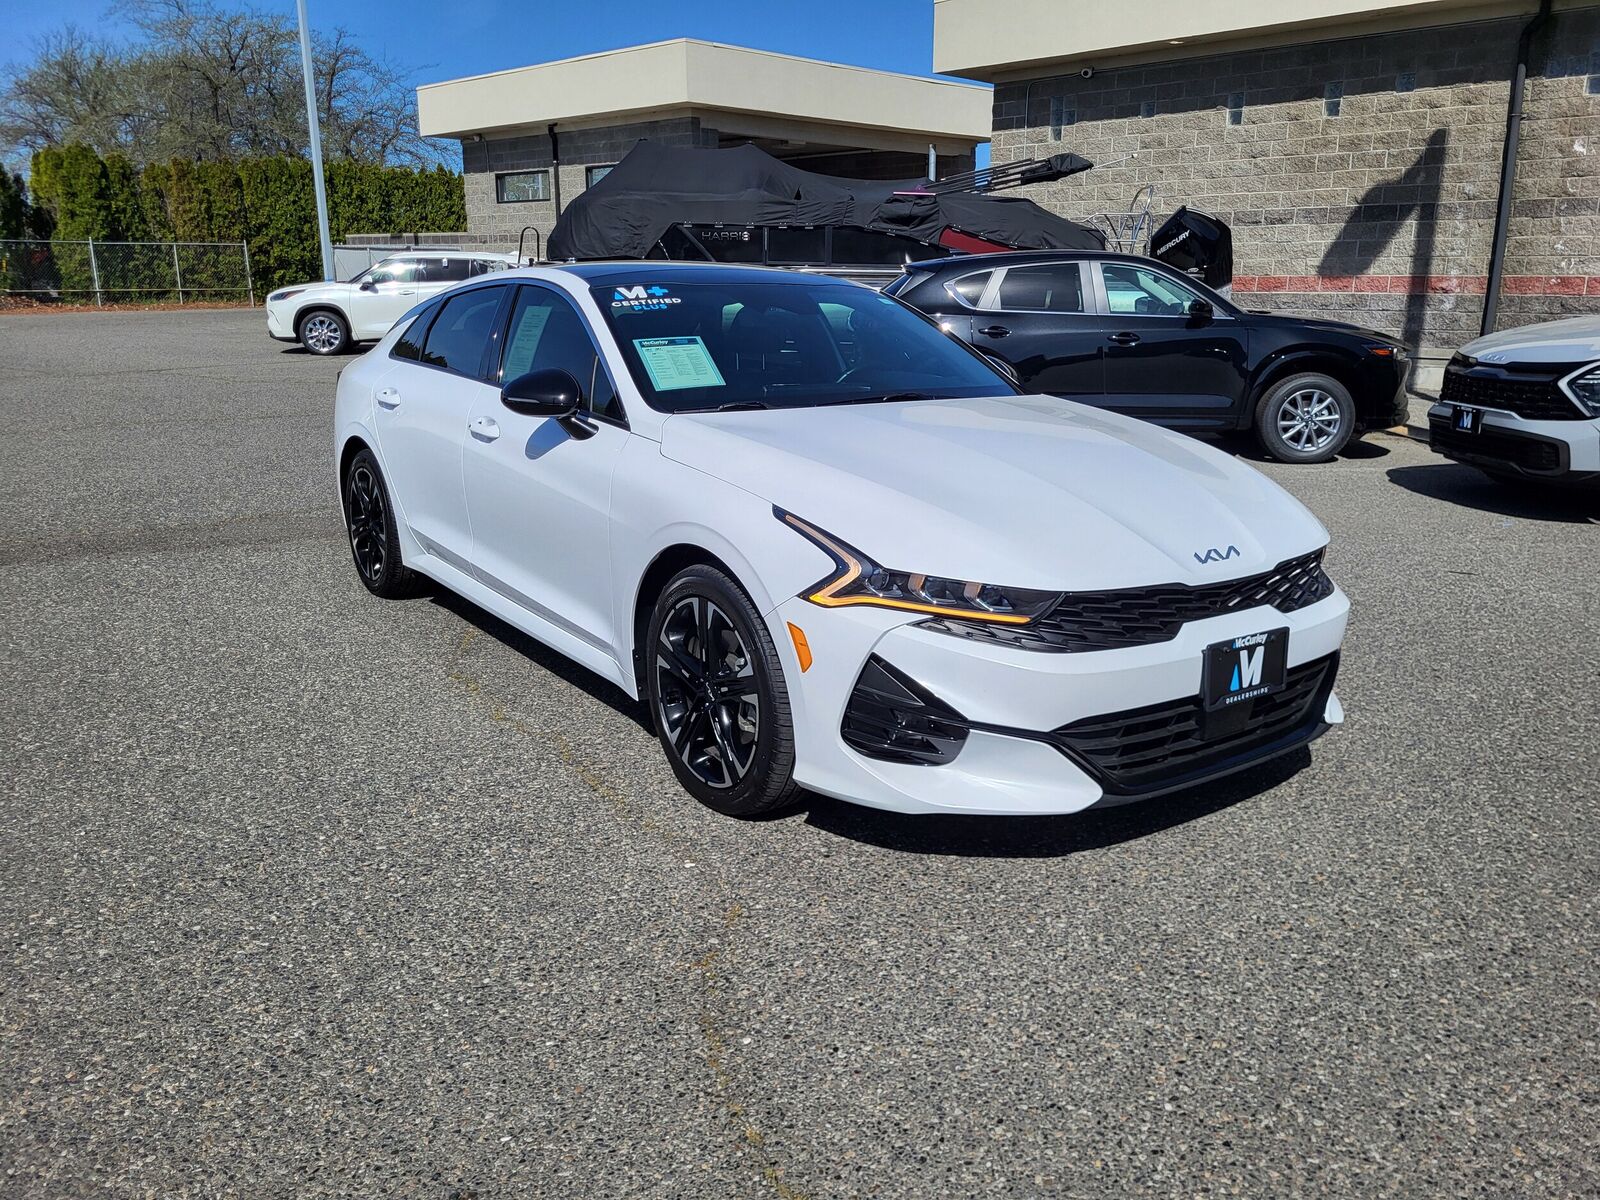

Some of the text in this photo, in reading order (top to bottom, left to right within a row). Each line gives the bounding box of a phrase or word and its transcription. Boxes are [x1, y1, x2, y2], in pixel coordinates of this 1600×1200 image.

[702, 231, 750, 240] HARRIS
[1156, 229, 1190, 255] MERCURY
[611, 297, 682, 307] CERTIFIED
[1193, 545, 1241, 564] KIA
[1233, 633, 1268, 649] McCurley
[1225, 688, 1269, 705] DEALERSHIPS
